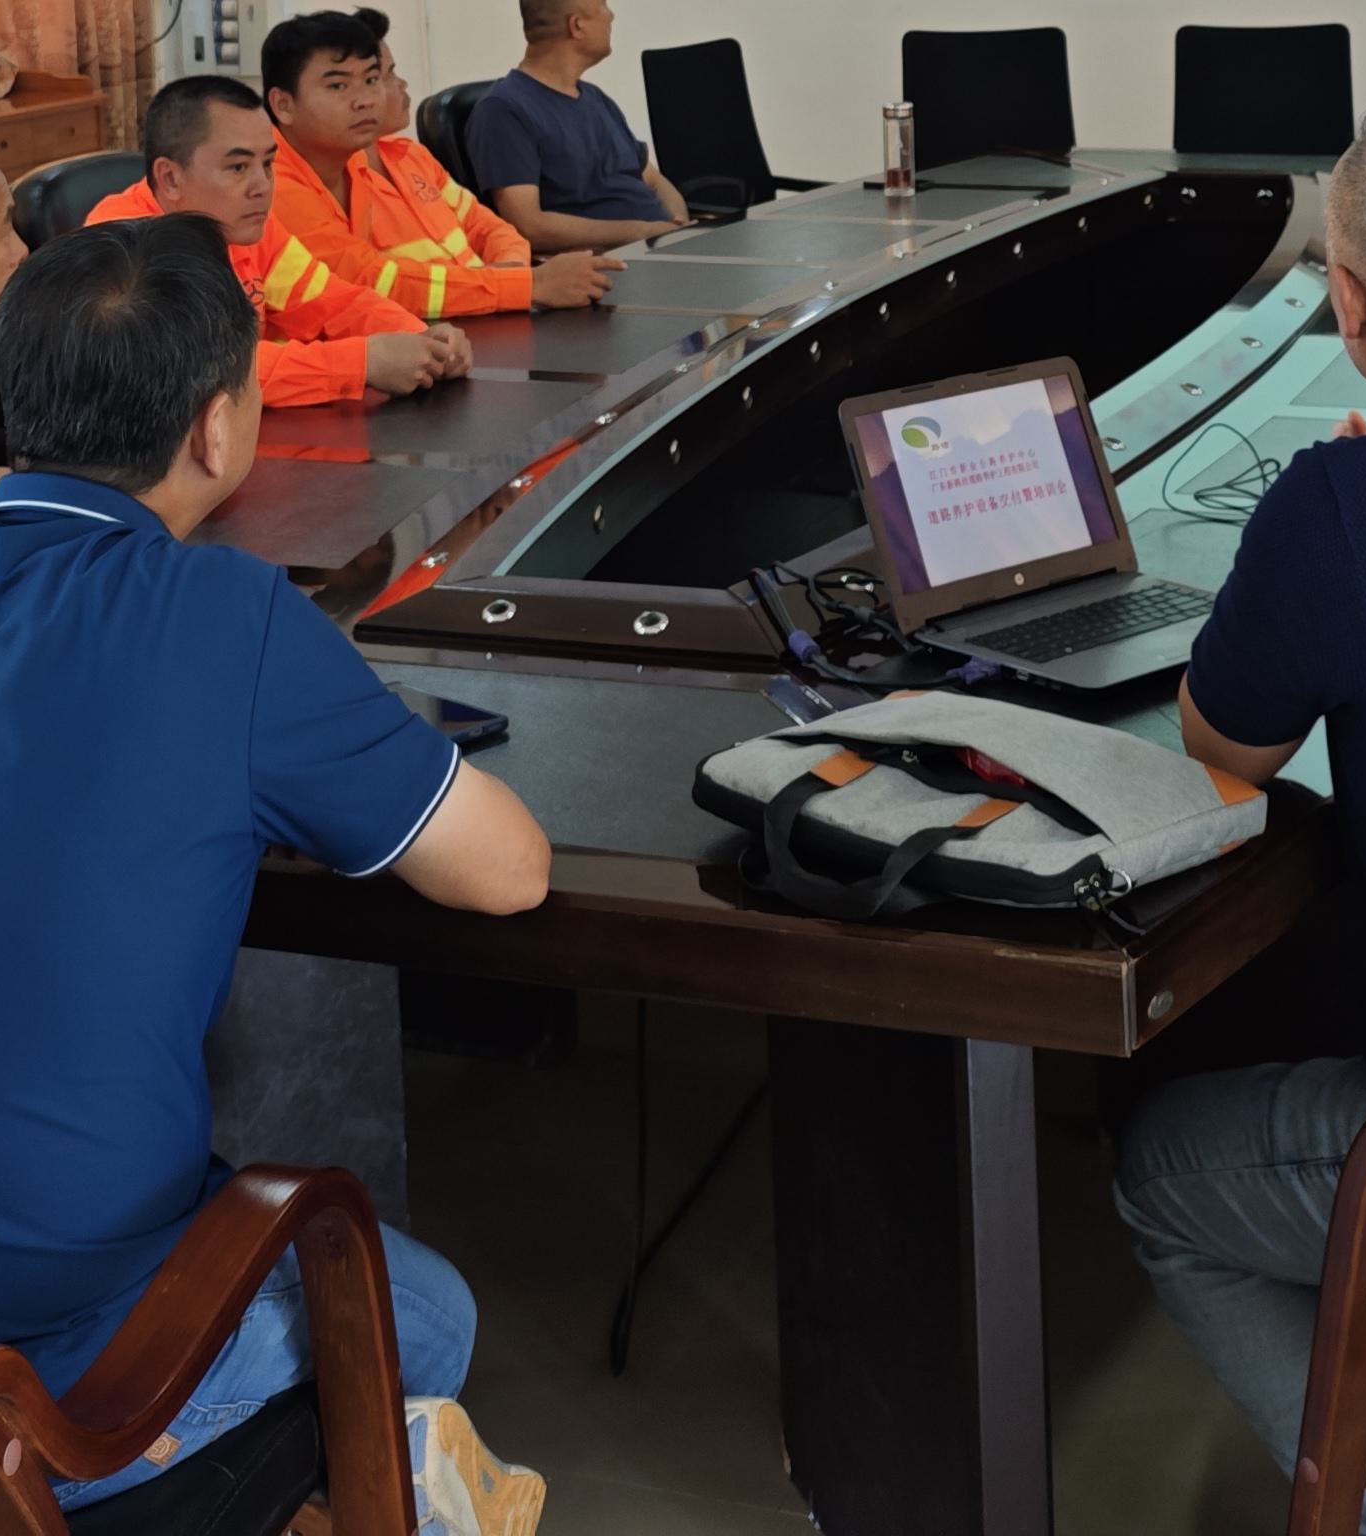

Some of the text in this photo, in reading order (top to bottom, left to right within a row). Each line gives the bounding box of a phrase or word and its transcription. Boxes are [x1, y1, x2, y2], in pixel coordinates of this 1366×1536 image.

[927, 479, 1067, 525] 道路养护设备交付暨培训会
